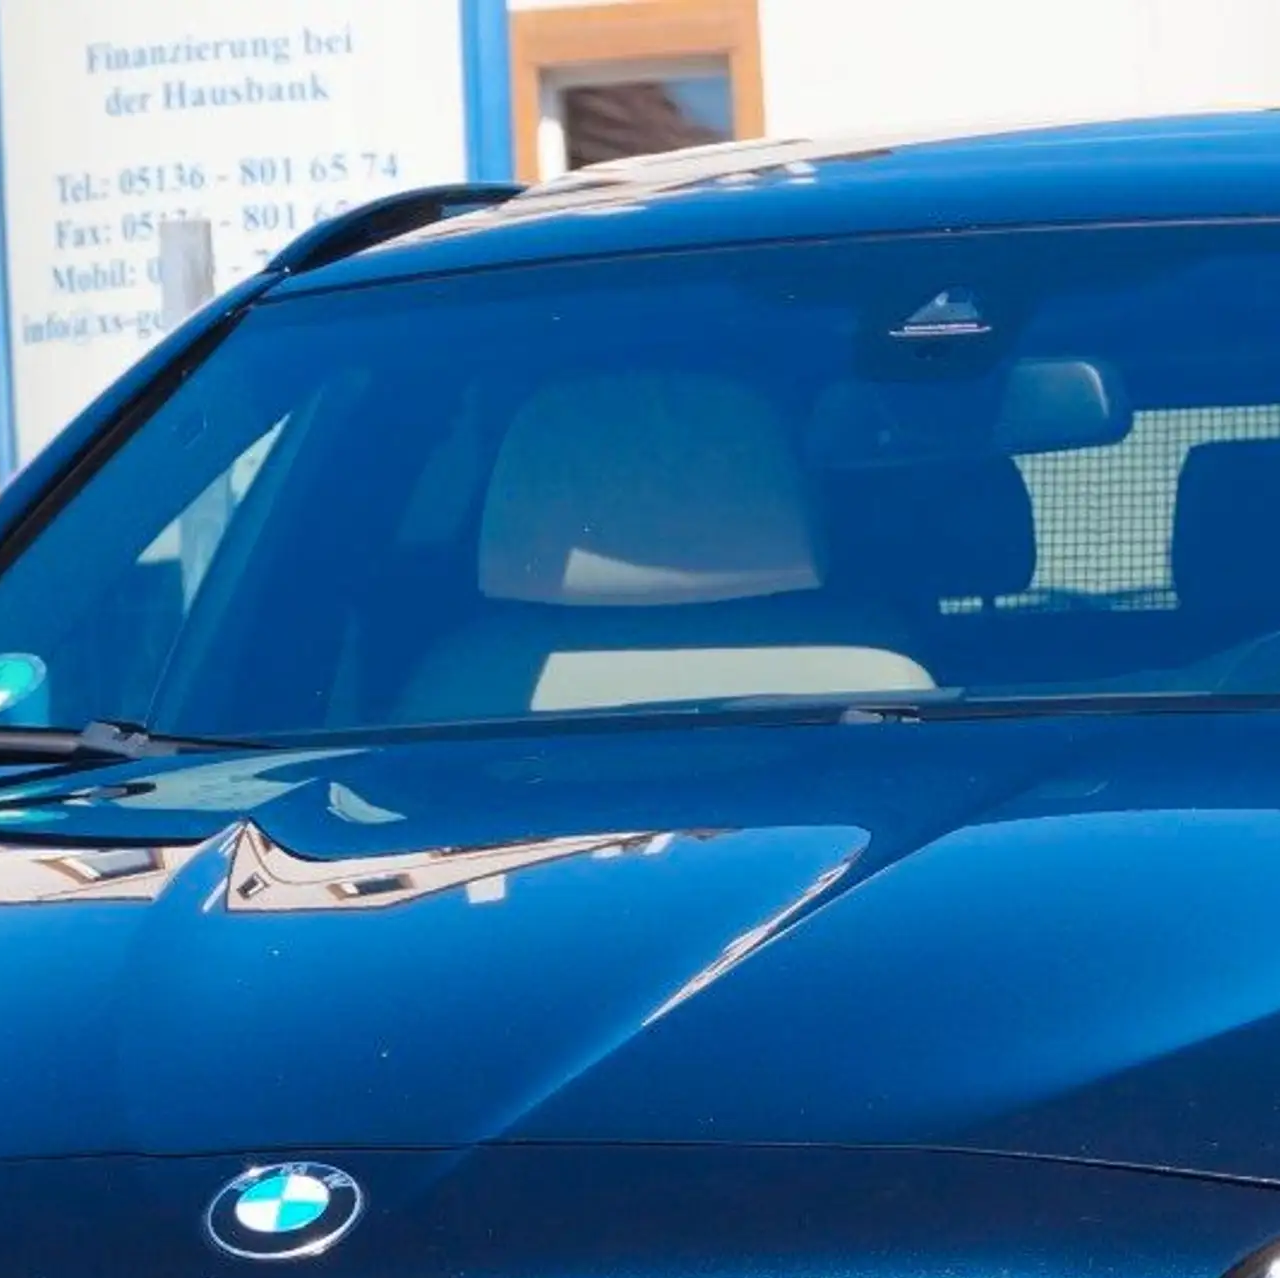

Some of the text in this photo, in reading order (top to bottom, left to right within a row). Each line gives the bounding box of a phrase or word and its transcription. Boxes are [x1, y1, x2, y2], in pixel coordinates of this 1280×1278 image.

[84, 21, 355, 74] Finanzierung bei
[104, 71, 331, 117] der Hausbank
[118, 161, 206, 196] 05136
[239, 155, 294, 187] 801
[309, 153, 349, 183] 65
[361, 150, 400, 180] 74
[54, 220, 113, 251] Fax:
[241, 202, 297, 231] 801
[51, 259, 137, 294] Mobil:
